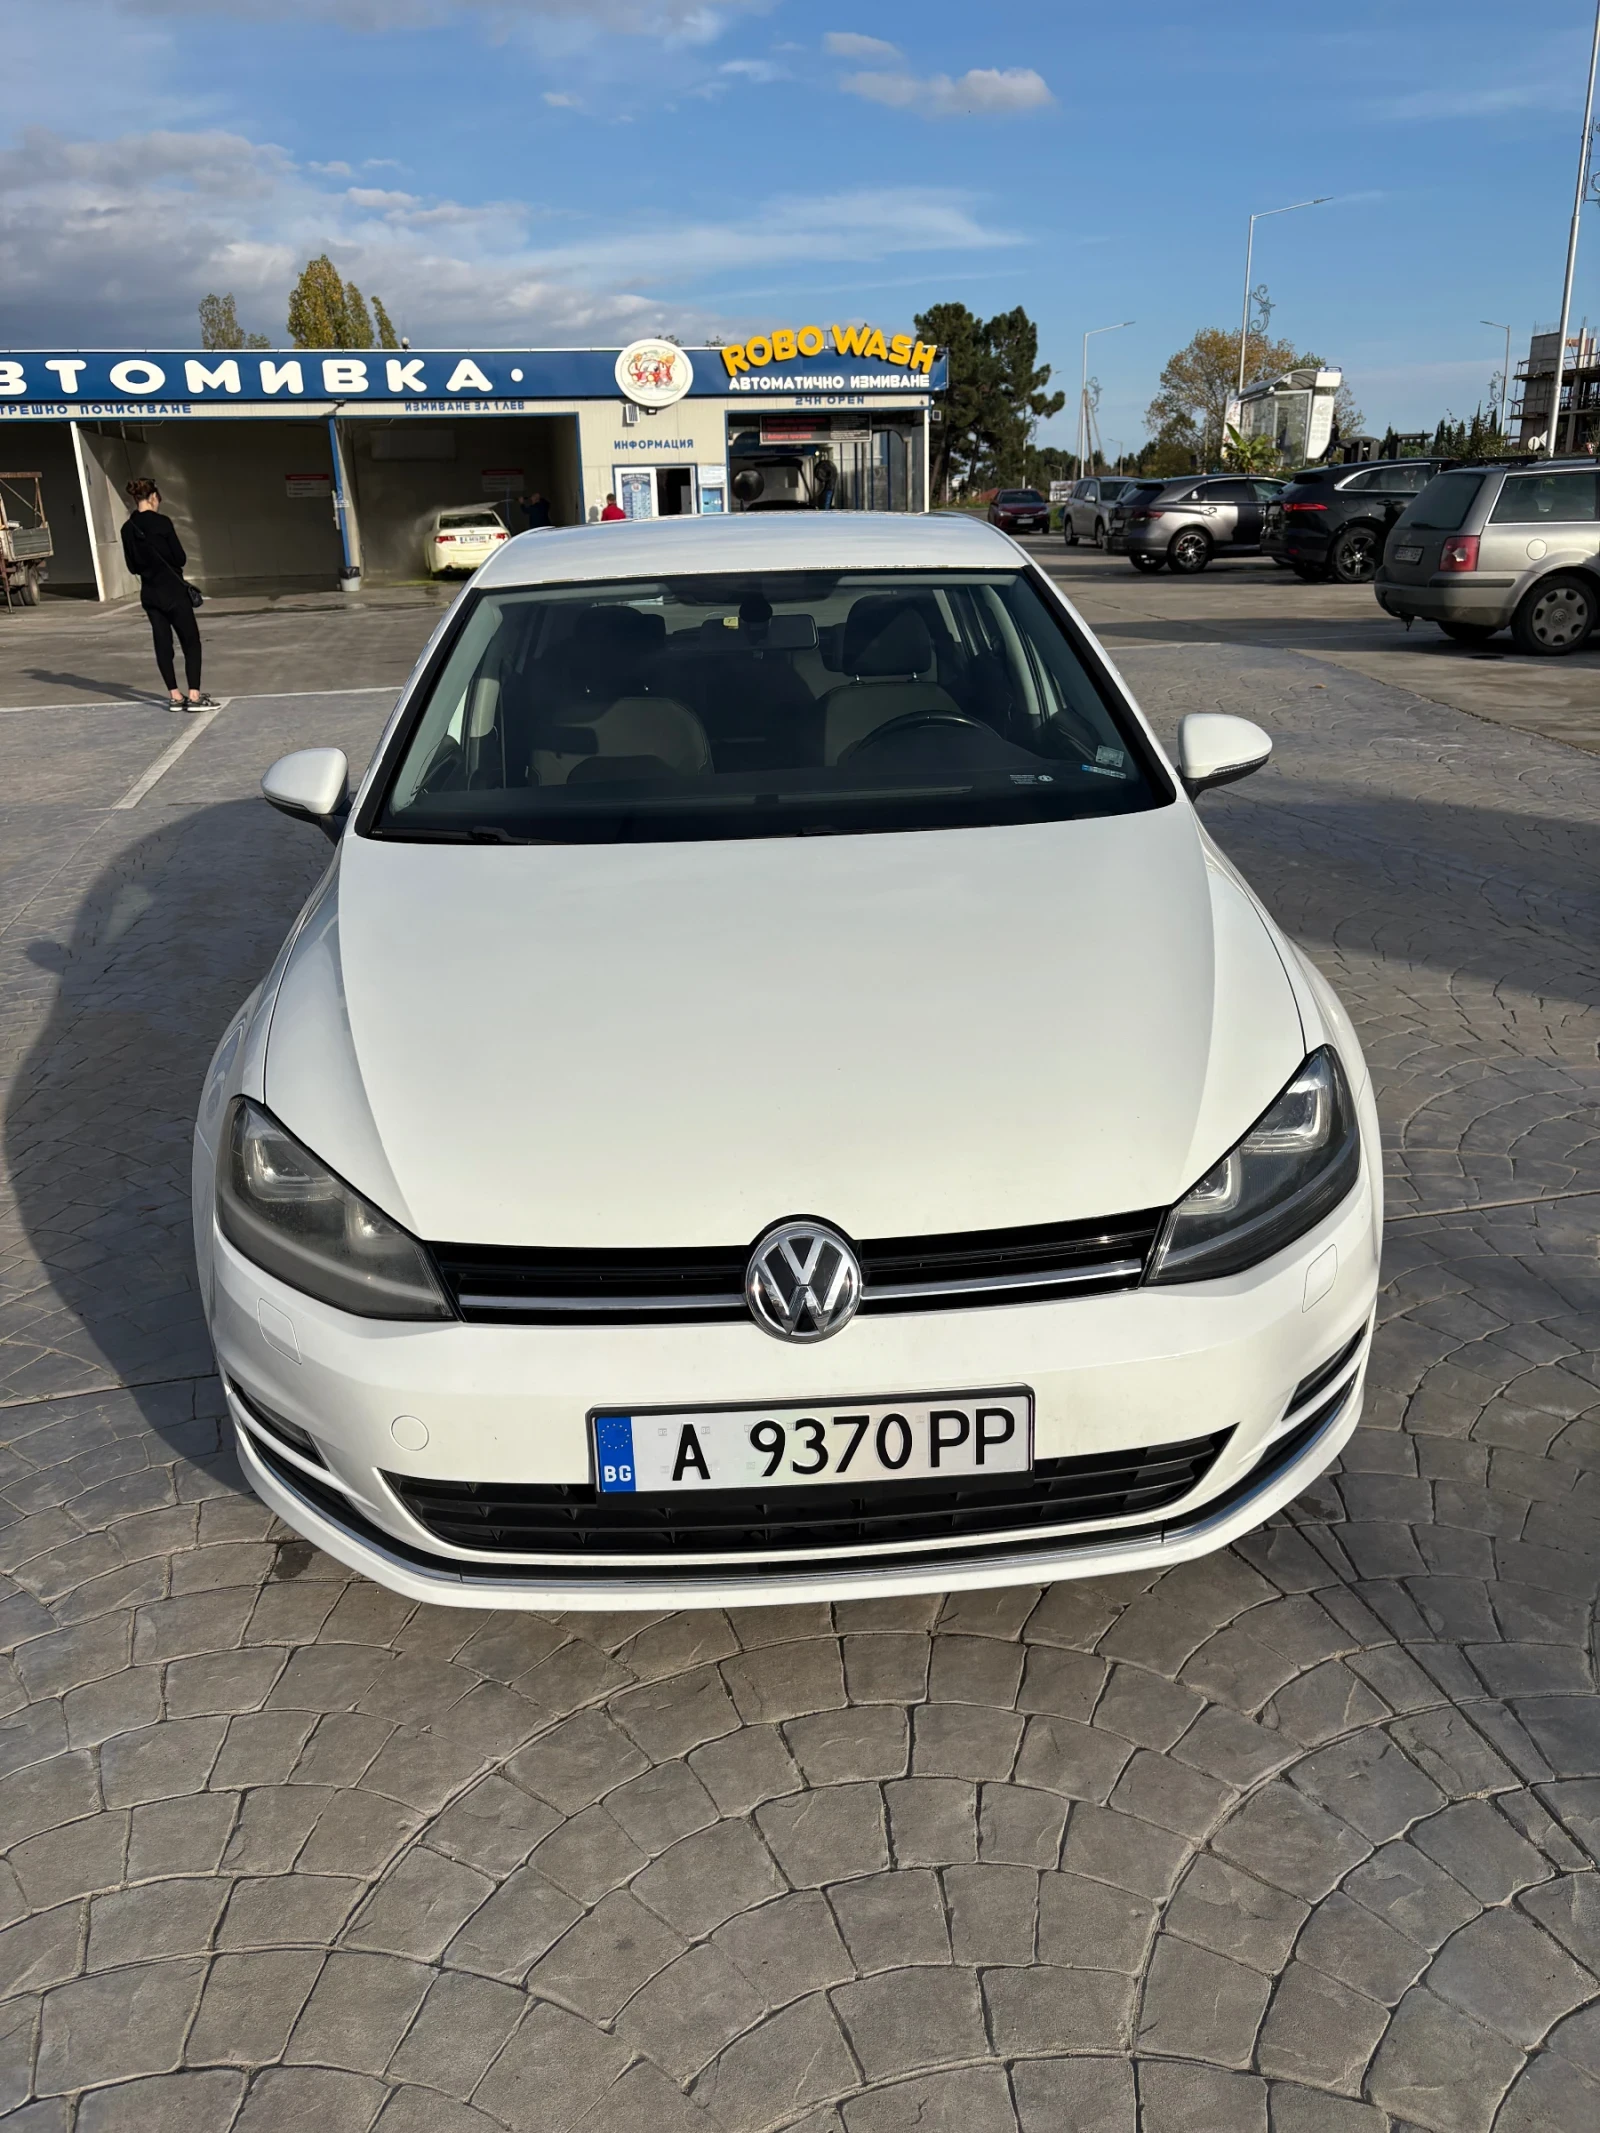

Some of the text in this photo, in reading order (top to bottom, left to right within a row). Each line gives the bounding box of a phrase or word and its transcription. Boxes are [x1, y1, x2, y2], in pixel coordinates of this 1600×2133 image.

[721, 324, 937, 377] ROBO WASH
[728, 374, 930, 391] АВТОМАТИЧНО ИЗМИВАНЕ
[404, 401, 470, 412] ИЗМИВАНЕ
[474, 401, 490, 411] ЗА
[827, 395, 864, 405] OPEN
[80, 403, 192, 415] ПОЧИСТВАНЕ
[614, 439, 694, 450] ИНФОРМАЦИЯ
[671, 1407, 1016, 1481] A 9370 PP
[603, 1464, 632, 1483] BG
